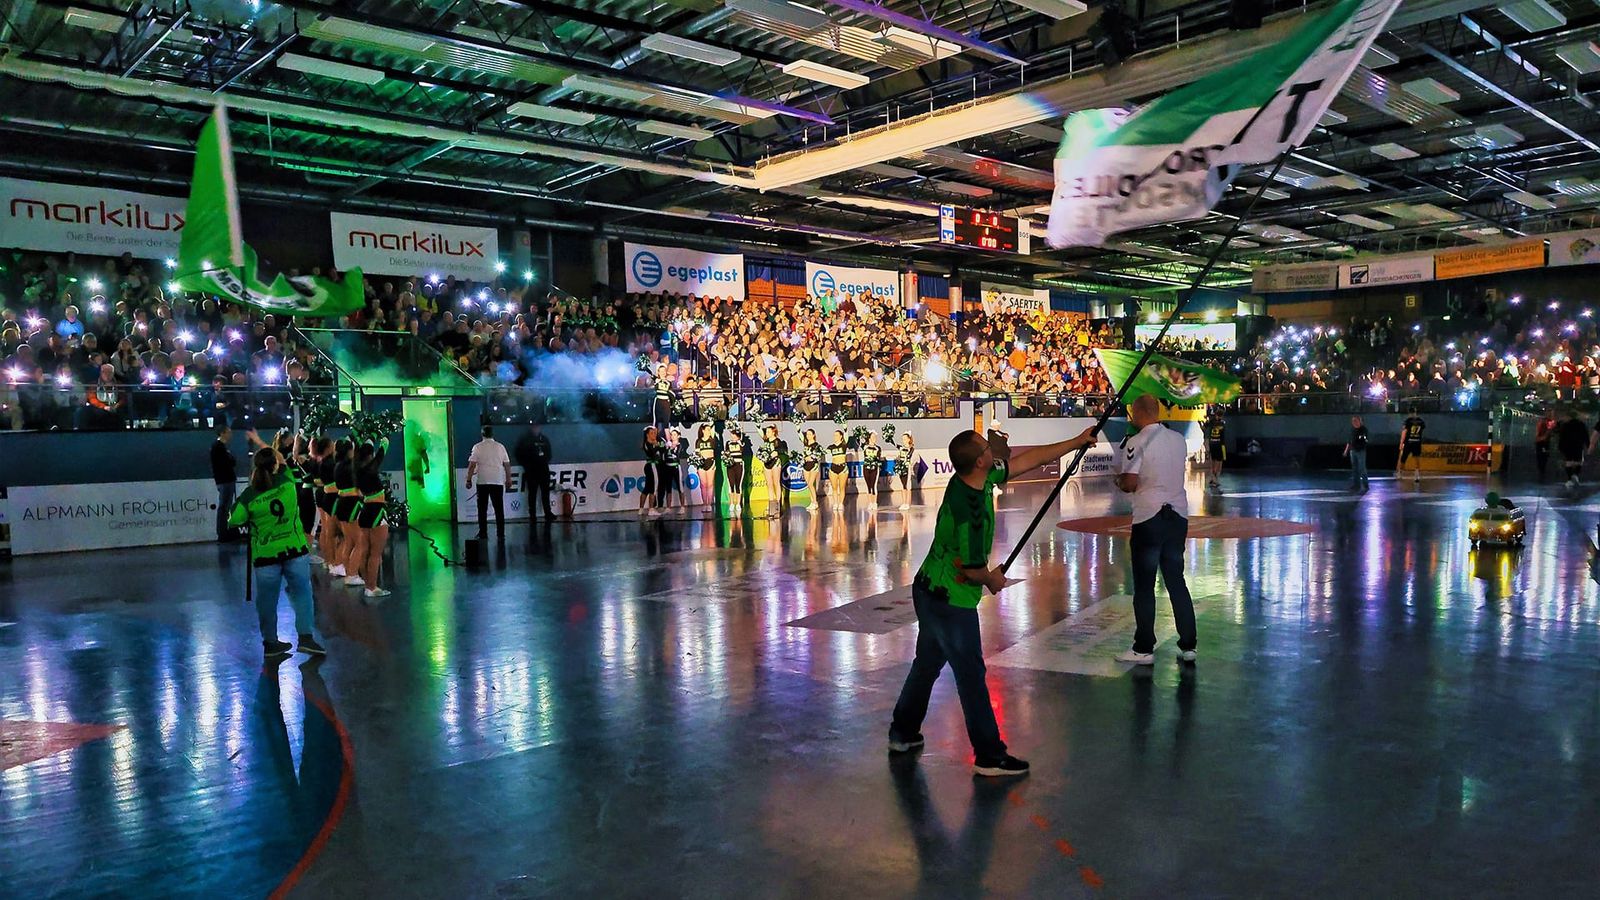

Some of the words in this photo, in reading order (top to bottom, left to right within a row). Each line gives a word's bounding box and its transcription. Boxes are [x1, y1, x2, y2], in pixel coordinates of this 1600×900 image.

[349, 230, 484, 257] markilux
[667, 265, 738, 284] egeplast
[839, 282, 895, 297] egeplast
[1081, 463, 1109, 473] Emsdetten
[1083, 454, 1113, 463] Stadtwerke
[22, 503, 115, 522] ALPMANN
[122, 498, 209, 517] FRÖHLICH
[269, 498, 285, 525] 9
